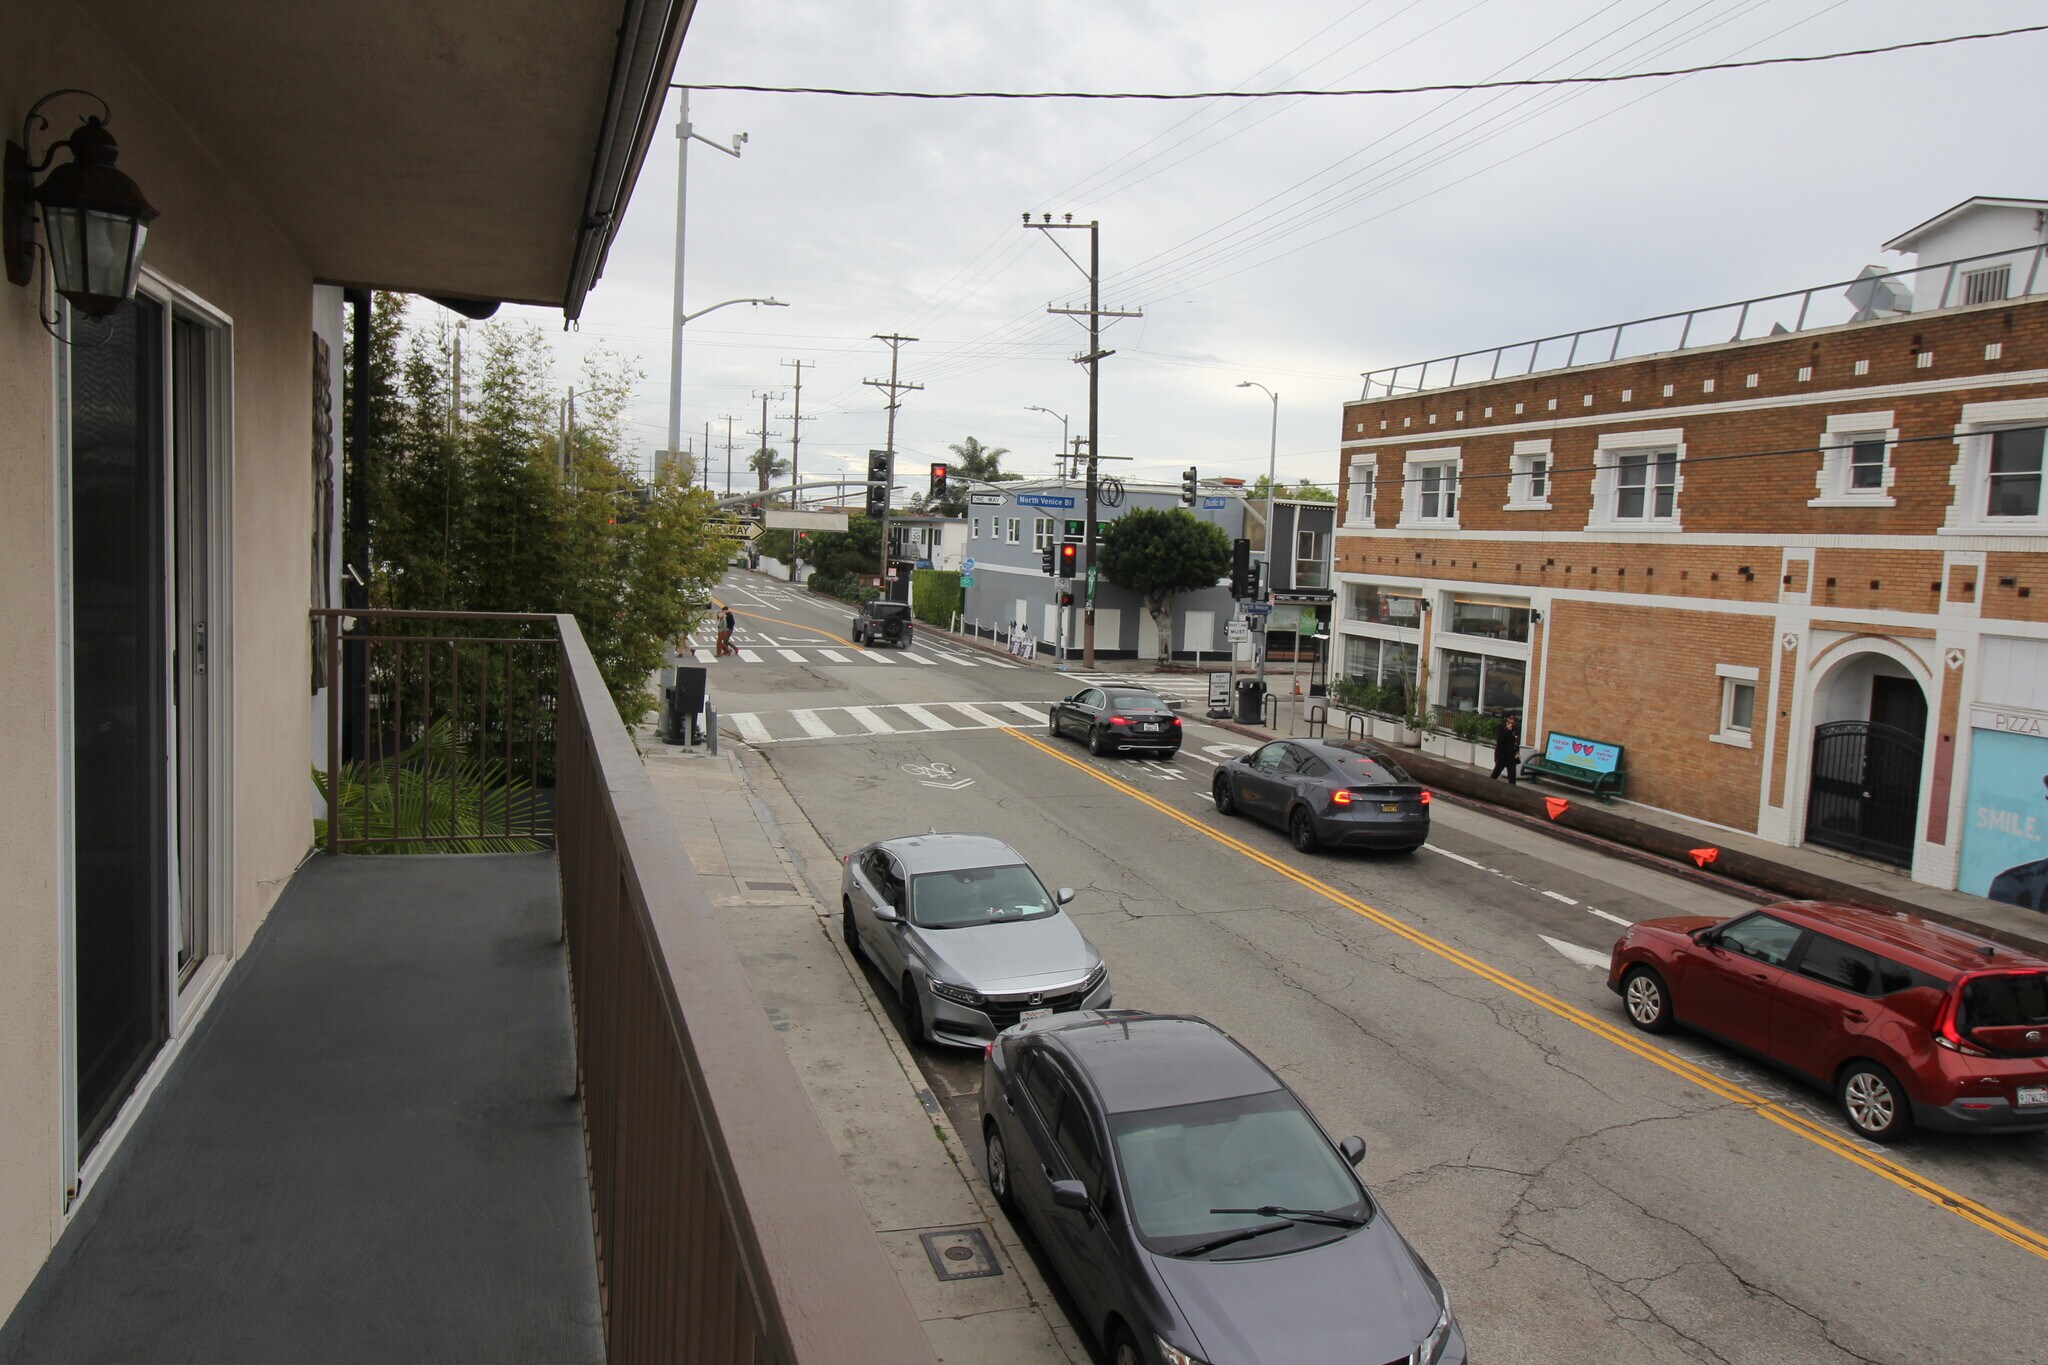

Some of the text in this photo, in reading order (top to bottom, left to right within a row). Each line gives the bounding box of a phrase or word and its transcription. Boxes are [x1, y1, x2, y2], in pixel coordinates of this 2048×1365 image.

[1019, 496, 1039, 504] North
[1040, 497, 1062, 506] Venice
[729, 524, 750, 535] WAY
[1996, 714, 2042, 735] PIZZA
[1976, 806, 2043, 842] SMILE.
